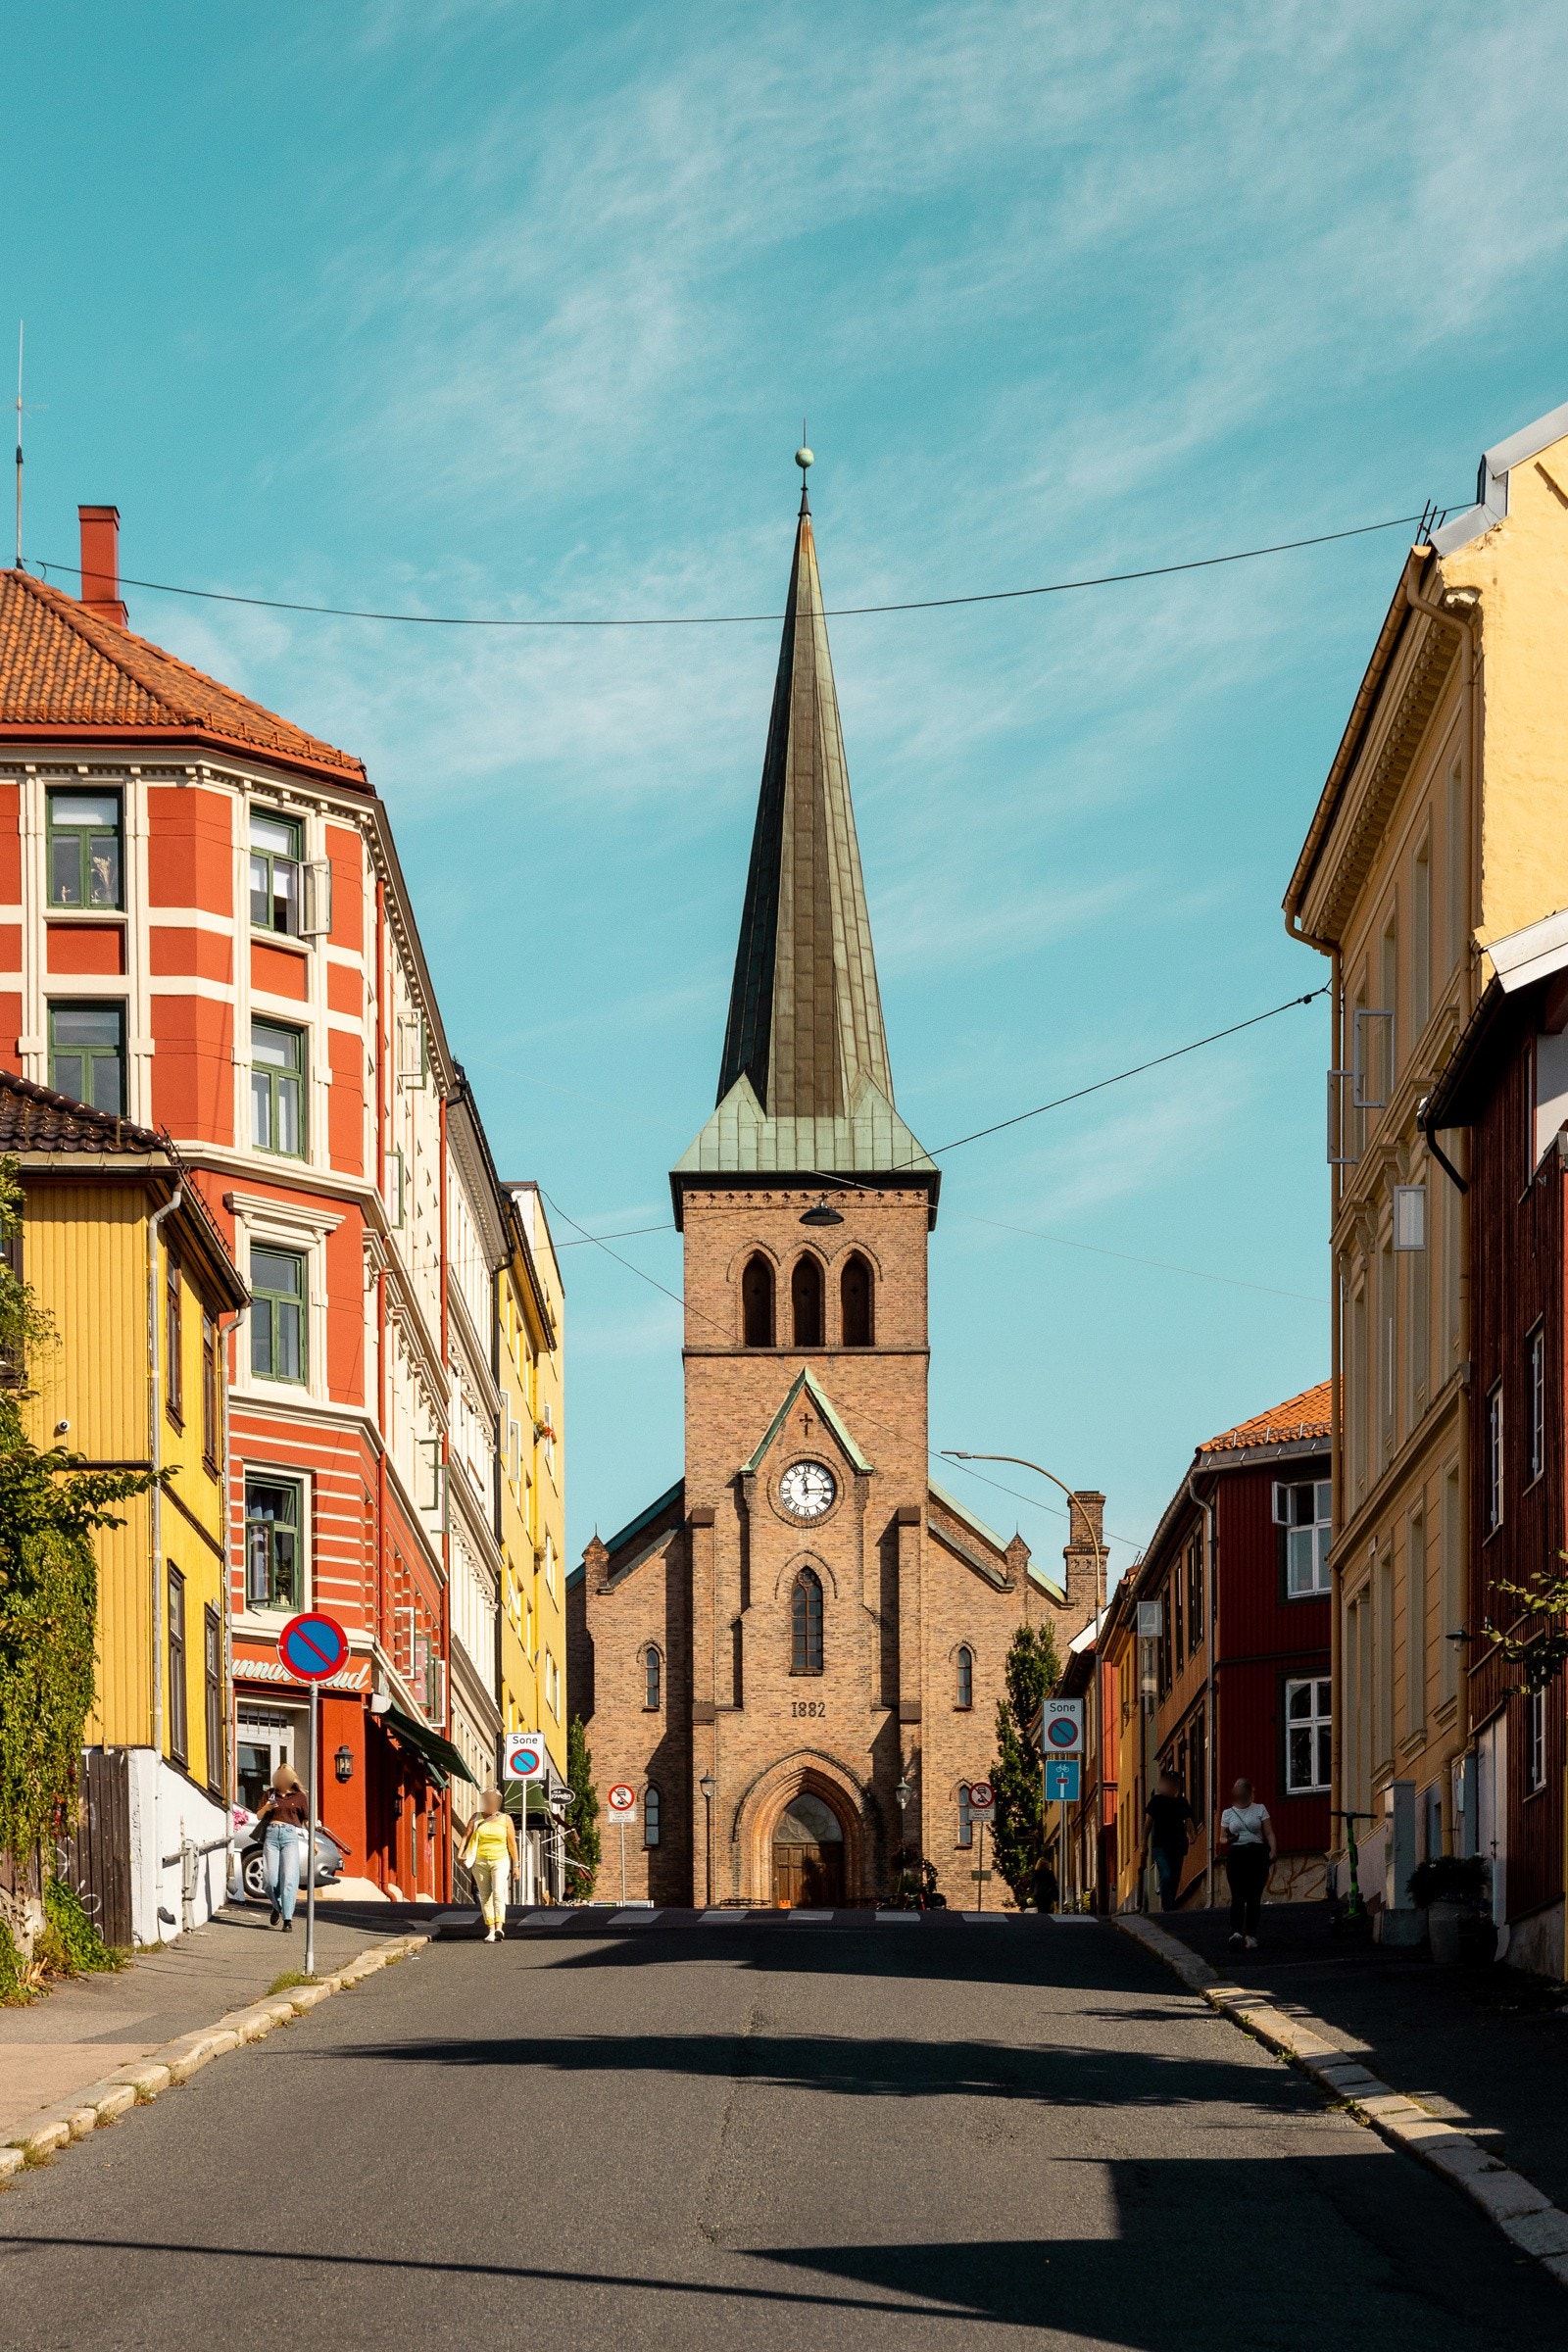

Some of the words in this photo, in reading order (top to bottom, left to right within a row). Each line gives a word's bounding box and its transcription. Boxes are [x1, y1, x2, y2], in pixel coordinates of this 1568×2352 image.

[225, 1658, 293, 1682] unnar
[791, 1701, 826, 1718] 1882
[1050, 1702, 1076, 1713] Sone
[513, 1736, 538, 1744] Sone
